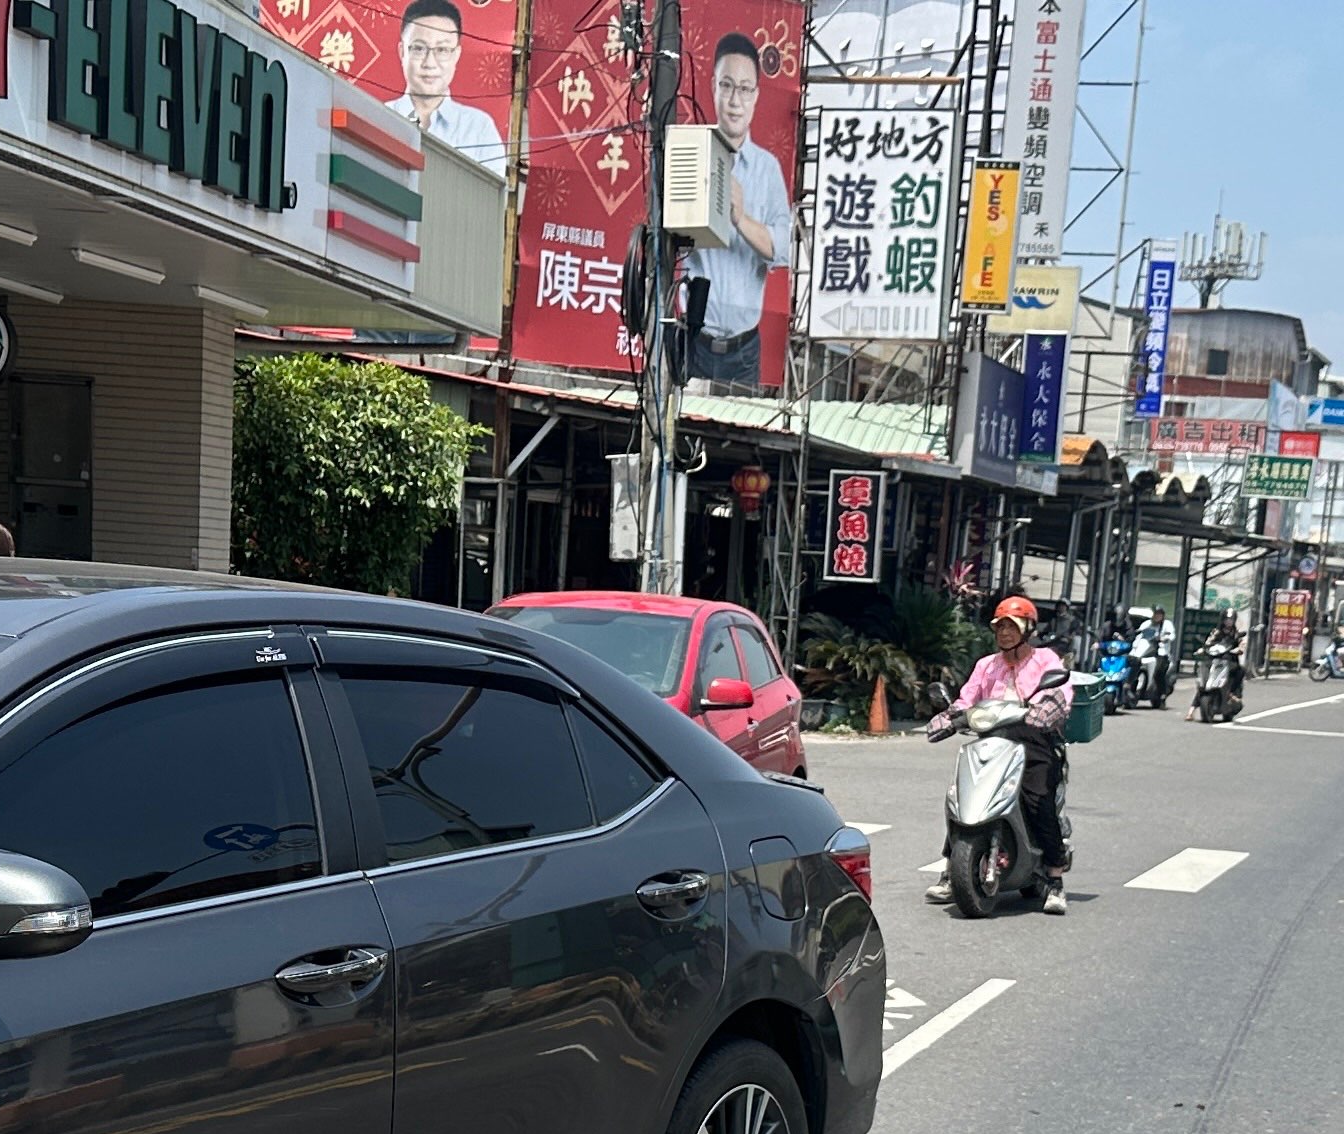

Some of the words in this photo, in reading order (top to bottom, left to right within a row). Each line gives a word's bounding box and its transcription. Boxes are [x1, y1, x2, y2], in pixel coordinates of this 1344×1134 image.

[558, 65, 595, 118] 快
[596, 133, 630, 186] 年
[822, 116, 950, 166] 好地方
[541, 222, 605, 249] 屏東縣議員
[818, 172, 878, 295] 遊戲
[883, 171, 944, 295] 釣蝦
